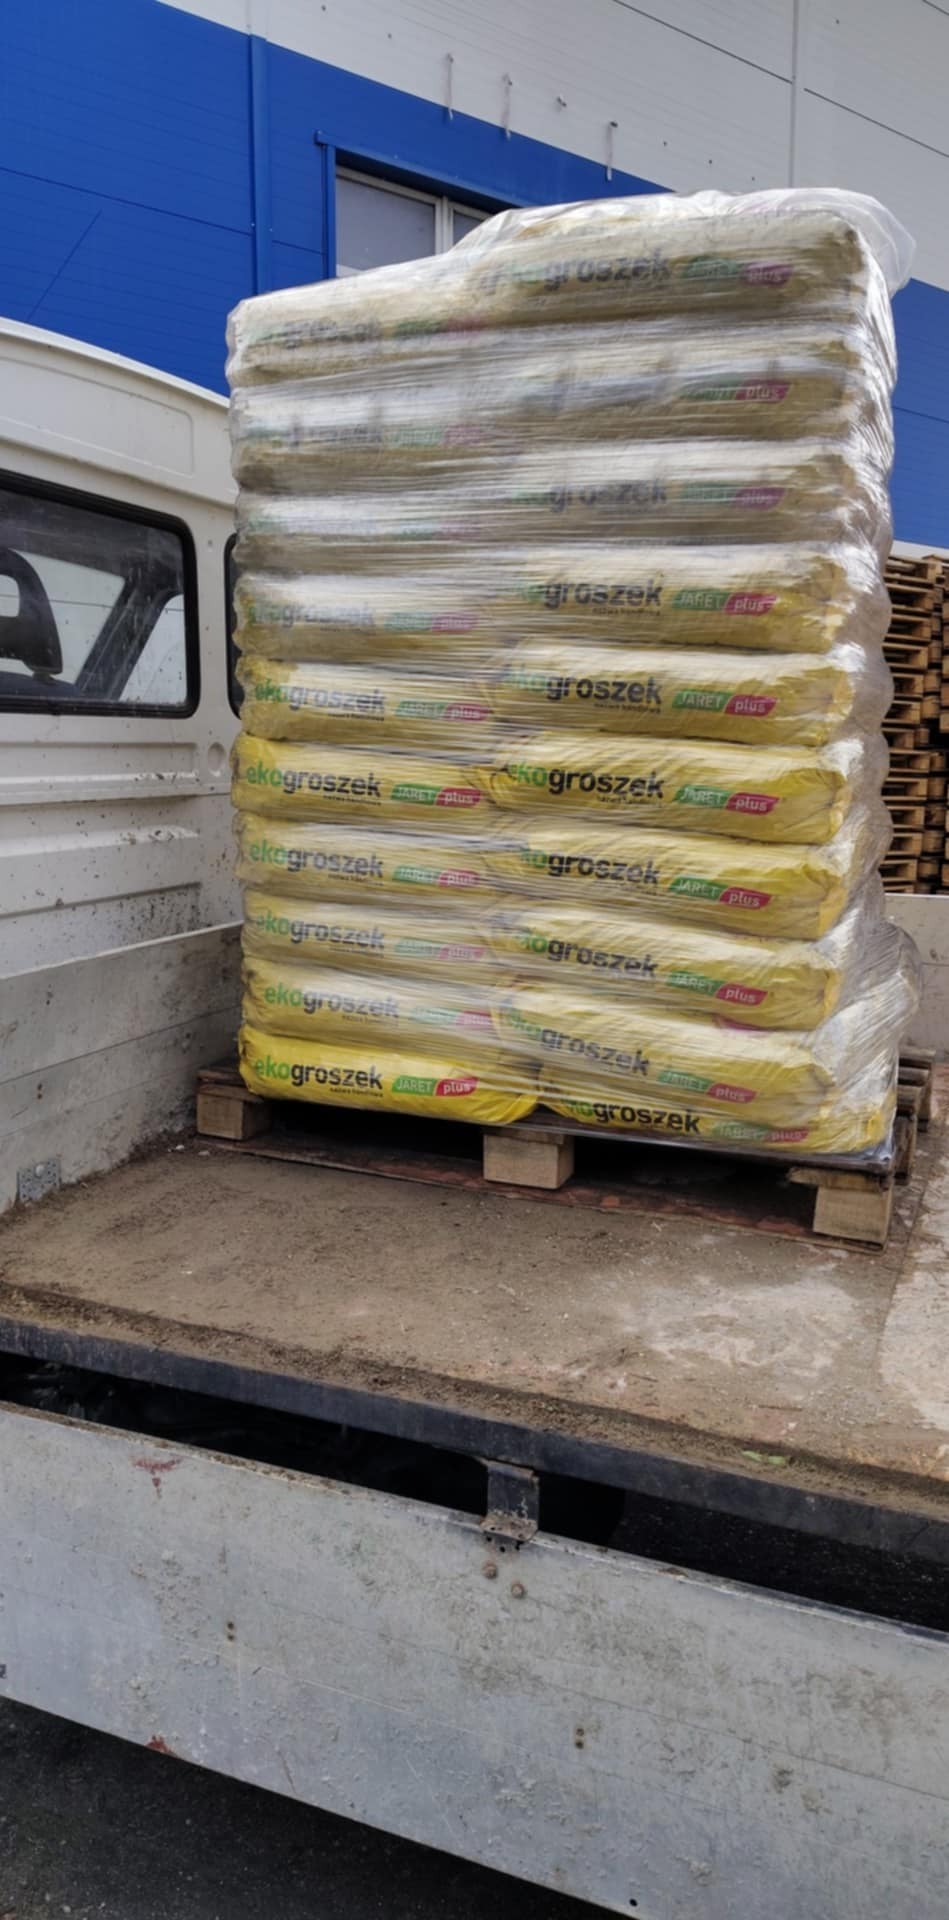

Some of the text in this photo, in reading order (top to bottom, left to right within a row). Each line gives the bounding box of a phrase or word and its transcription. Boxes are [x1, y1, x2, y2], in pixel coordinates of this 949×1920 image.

[517, 578, 766, 613] ogroszek JARET plus
[254, 679, 386, 714] ekogroszek
[450, 704, 481, 721] plus
[681, 691, 723, 710] JARET
[734, 697, 766, 715] plus
[246, 761, 382, 798] ekogroszek
[444, 789, 474, 806] plus
[681, 786, 725, 806] JARET
[734, 794, 768, 813] plus
[250, 839, 384, 877] ekogroszek
[675, 878, 721, 898] JARET
[728, 889, 762, 908] plus
[255, 910, 385, 950] ekogroszek
[264, 983, 400, 1018] ekogroszek
[724, 986, 757, 1004] plus
[254, 1055, 472, 1096] ekogroszek JARET plus
[715, 1084, 748, 1102] plus
